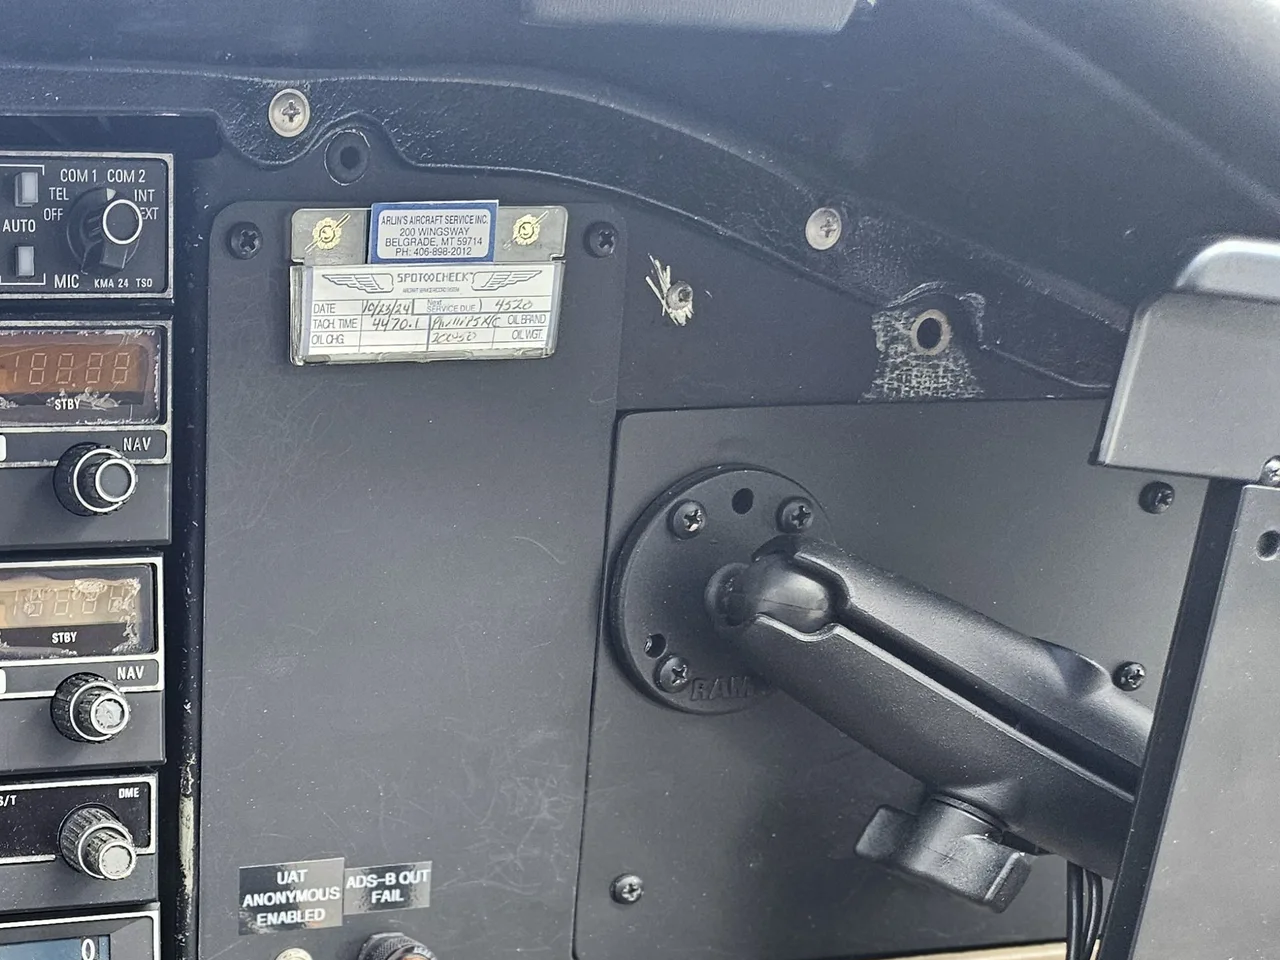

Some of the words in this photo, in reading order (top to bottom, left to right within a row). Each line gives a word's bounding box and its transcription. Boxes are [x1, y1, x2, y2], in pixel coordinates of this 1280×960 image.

[60, 169, 88, 183] COM
[107, 169, 136, 183] COM
[138, 169, 146, 183] 2
[49, 188, 69, 201] TEL
[134, 189, 155, 202] INT
[43, 208, 63, 222] OFF
[409, 215, 443, 224] AIRCRAFT
[445, 215, 473, 224] SERVICE
[475, 215, 488, 224] INC.
[2, 218, 36, 234] AUTO
[400, 228, 415, 236] 200
[418, 227, 470, 236] WINGSWAY
[385, 237, 438, 247] BELGRADE,
[441, 237, 455, 245] MT
[457, 237, 482, 245] 59714
[396, 248, 411, 256] PH:
[414, 247, 471, 256] 406-898-2012
[54, 275, 80, 289] MIC
[94, 278, 115, 289] KMA
[117, 278, 129, 289] 24
[136, 278, 153, 288] TSO
[313, 303, 336, 313] DATE
[123, 437, 152, 451] NAV
[51, 631, 78, 644] STBY
[117, 665, 145, 681] NAV
[277, 869, 308, 886] UAT
[346, 873, 396, 889] ADS-B
[399, 869, 430, 884] OUT
[242, 886, 341, 907] ANONYMOUS
[371, 888, 404, 903] FAIL
[256, 908, 326, 926] ENABLED
